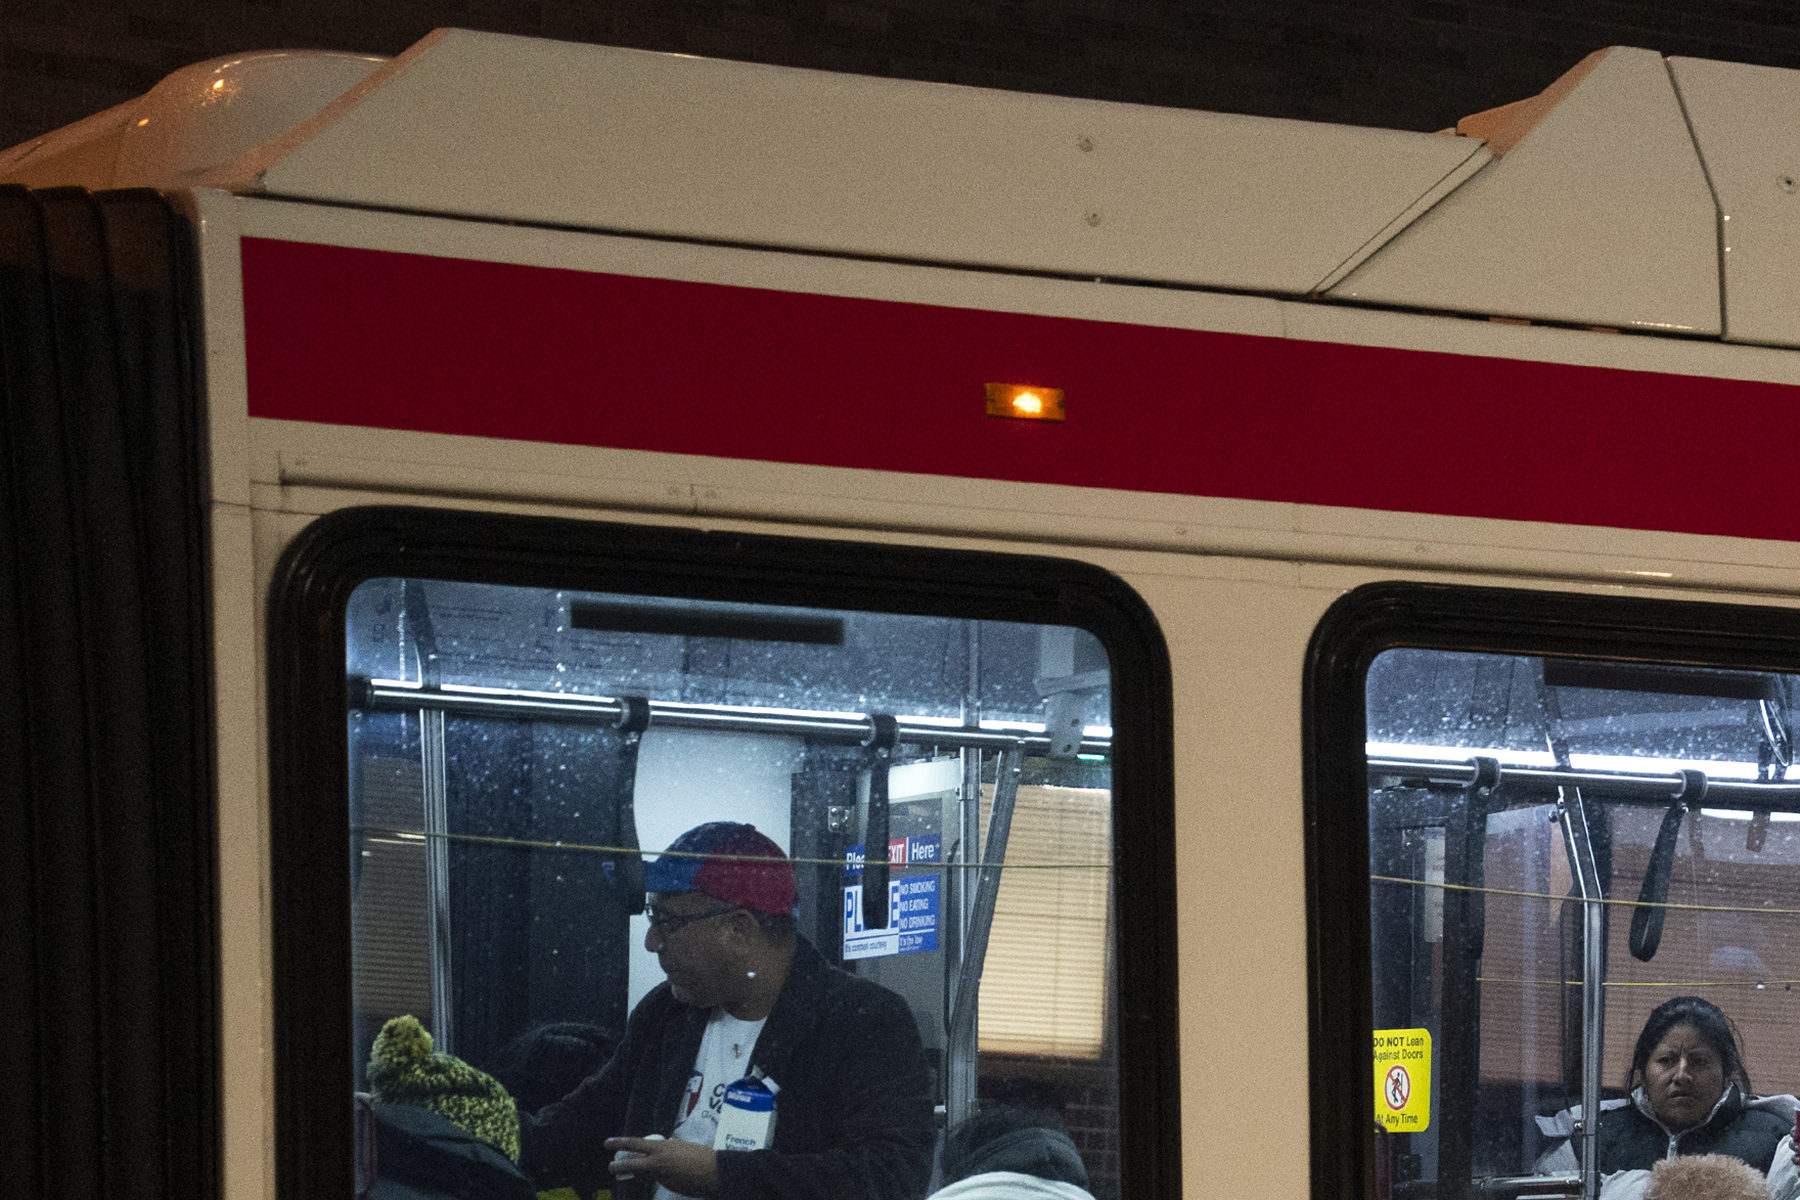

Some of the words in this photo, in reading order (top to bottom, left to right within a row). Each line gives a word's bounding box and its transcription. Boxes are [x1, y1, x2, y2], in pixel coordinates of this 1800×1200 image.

[846, 852, 865, 870] Plea
[911, 842, 934, 861] Here
[900, 884, 909, 895] NO
[909, 881, 935, 894] SMOKING
[846, 886, 899, 934] PLE
[900, 901, 908, 912] NO
[909, 898, 929, 911] EATING
[900, 917, 908, 929] NO
[909, 914, 935, 928] DRINKING
[1374, 1037, 1385, 1047] DO
[1387, 1037, 1404, 1047] NOT
[1406, 1036, 1424, 1046] Lean
[1374, 1049, 1400, 1063] Against
[1402, 1049, 1423, 1059] Doors
[1386, 1114, 1399, 1126] Any
[1401, 1113, 1418, 1124] Time
[726, 1134, 756, 1146] French
